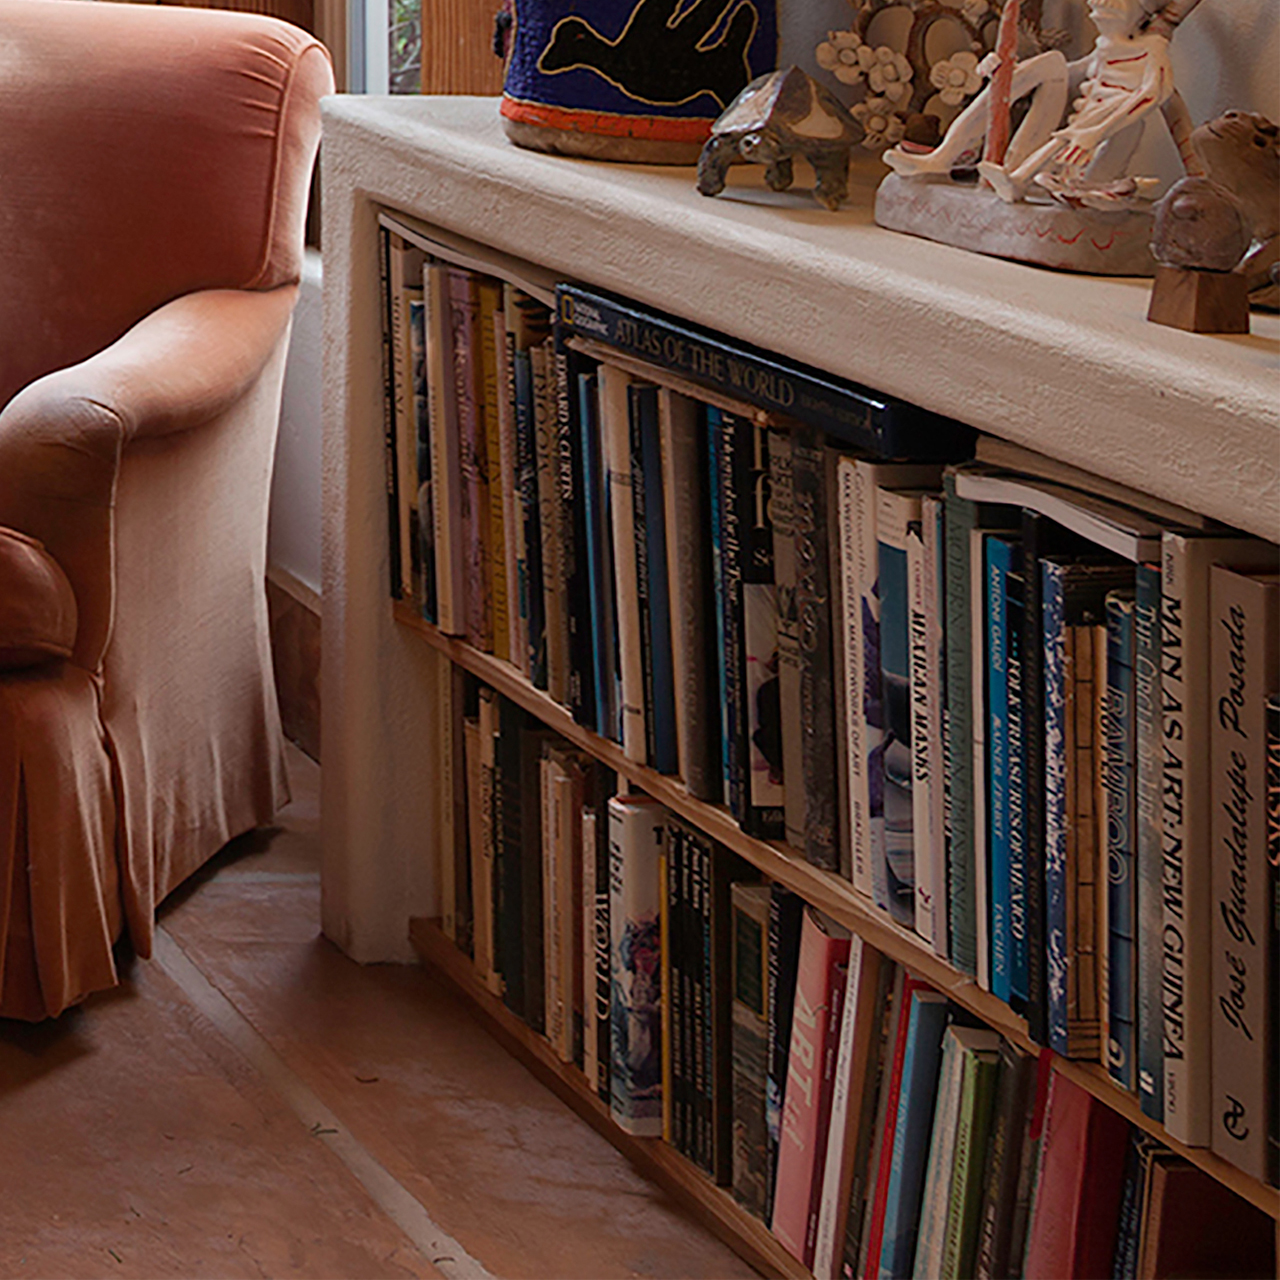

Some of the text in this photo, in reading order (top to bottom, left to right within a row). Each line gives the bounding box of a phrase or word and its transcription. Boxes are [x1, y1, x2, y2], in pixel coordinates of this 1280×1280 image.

[555, 352, 572, 423] EDWARD
[613, 318, 795, 409] ATLAS OF THE WORLD
[558, 438, 575, 501] CURTIS
[843, 471, 852, 500] MAX
[844, 503, 853, 561] WEGNER
[949, 521, 965, 628] MODERN
[846, 575, 855, 618] GREEK
[990, 563, 1001, 621] ANTONI
[848, 624, 860, 726] MASTERWORKS
[912, 609, 928, 706] MEXICAN
[1161, 593, 1183, 683] MAN
[1219, 603, 1248, 739] Posada
[851, 730, 860, 745] OF
[915, 710, 929, 783] MASKS
[992, 713, 1003, 777] RAINER
[1136, 605, 1158, 826] THE CIRCLE OF LIFE
[1162, 688, 1183, 741] AS
[852, 752, 861, 777] ART
[1006, 657, 1025, 941] FOLK TREASURES OF MEXICO
[1107, 684, 1128, 886] BAMBOO
[1162, 745, 1183, 829] ART:
[1162, 831, 1183, 919] NEW
[1220, 750, 1256, 946] Guadalupe
[595, 891, 610, 1023] WORLD
[994, 903, 1006, 976] TASCHEN
[1162, 923, 1184, 1060] GUINEA
